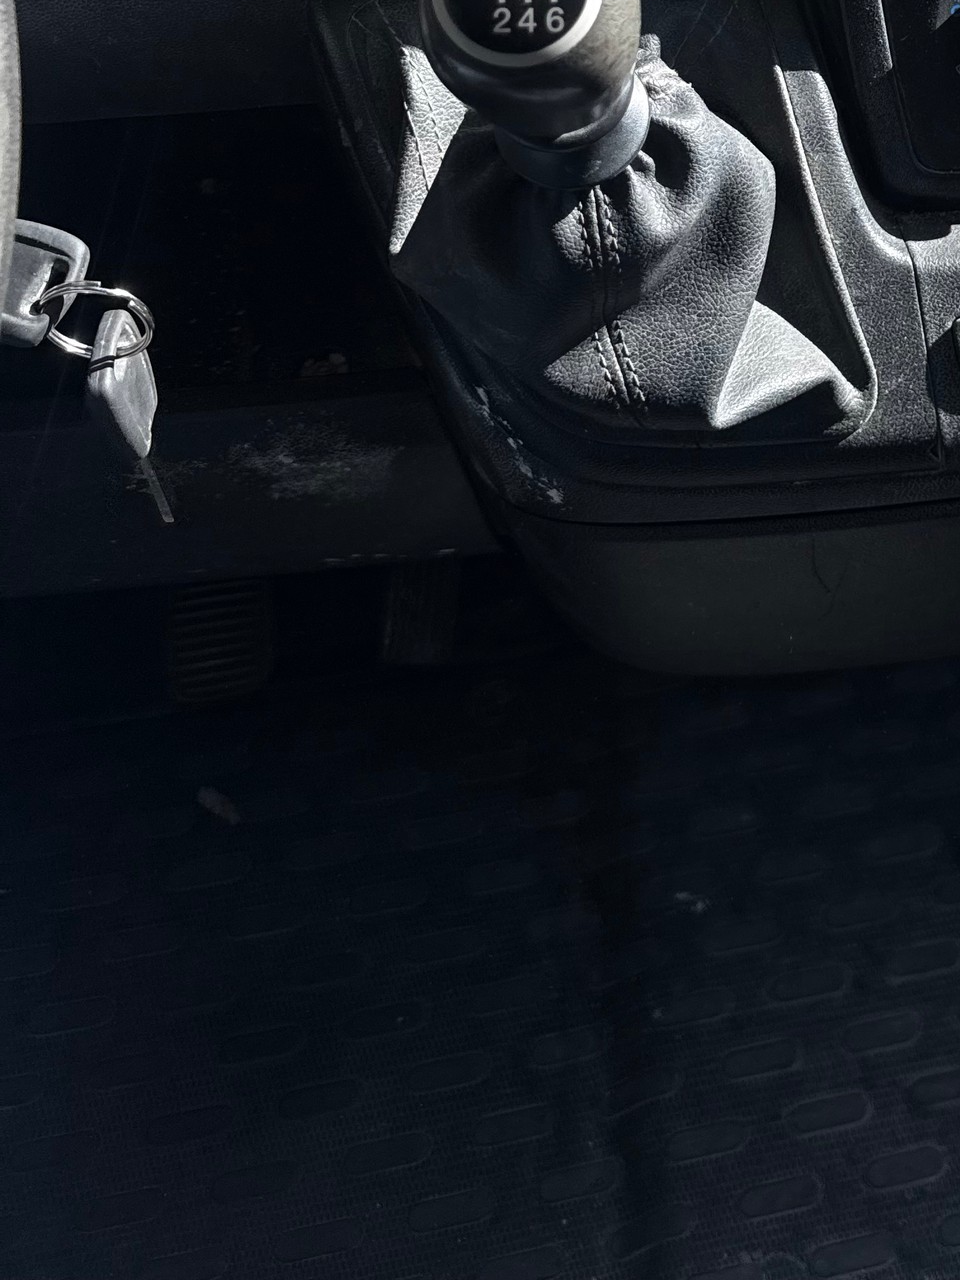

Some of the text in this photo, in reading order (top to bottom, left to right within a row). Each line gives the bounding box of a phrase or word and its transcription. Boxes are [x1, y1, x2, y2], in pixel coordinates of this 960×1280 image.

[493, 6, 565, 34] 2 4 6
